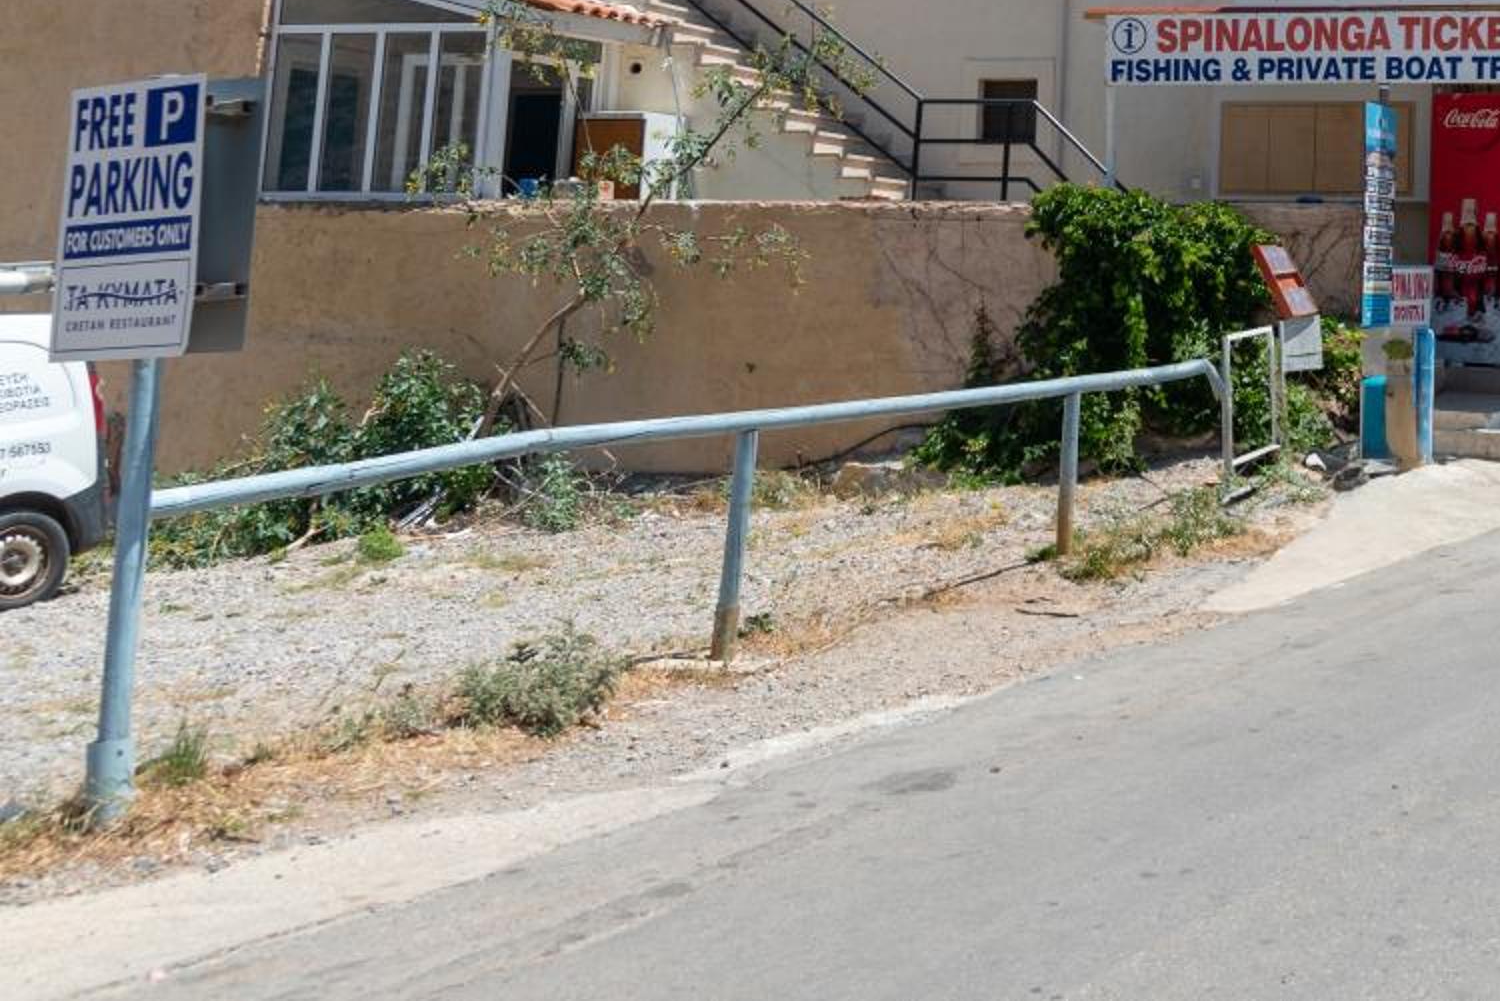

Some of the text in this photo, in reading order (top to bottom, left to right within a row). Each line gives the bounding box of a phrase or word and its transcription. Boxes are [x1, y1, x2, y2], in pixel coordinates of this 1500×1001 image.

[1157, 17, 1391, 53] SPINALONGA
[1111, 57, 1222, 82] FISHING
[1231, 57, 1251, 81] &
[1258, 56, 1376, 81] PRIVATE
[1386, 56, 1462, 80] BOAT
[74, 90, 185, 152] FREE P
[67, 151, 193, 218] PARKING
[65, 222, 191, 255] FOR CUSTOMERS ONLY
